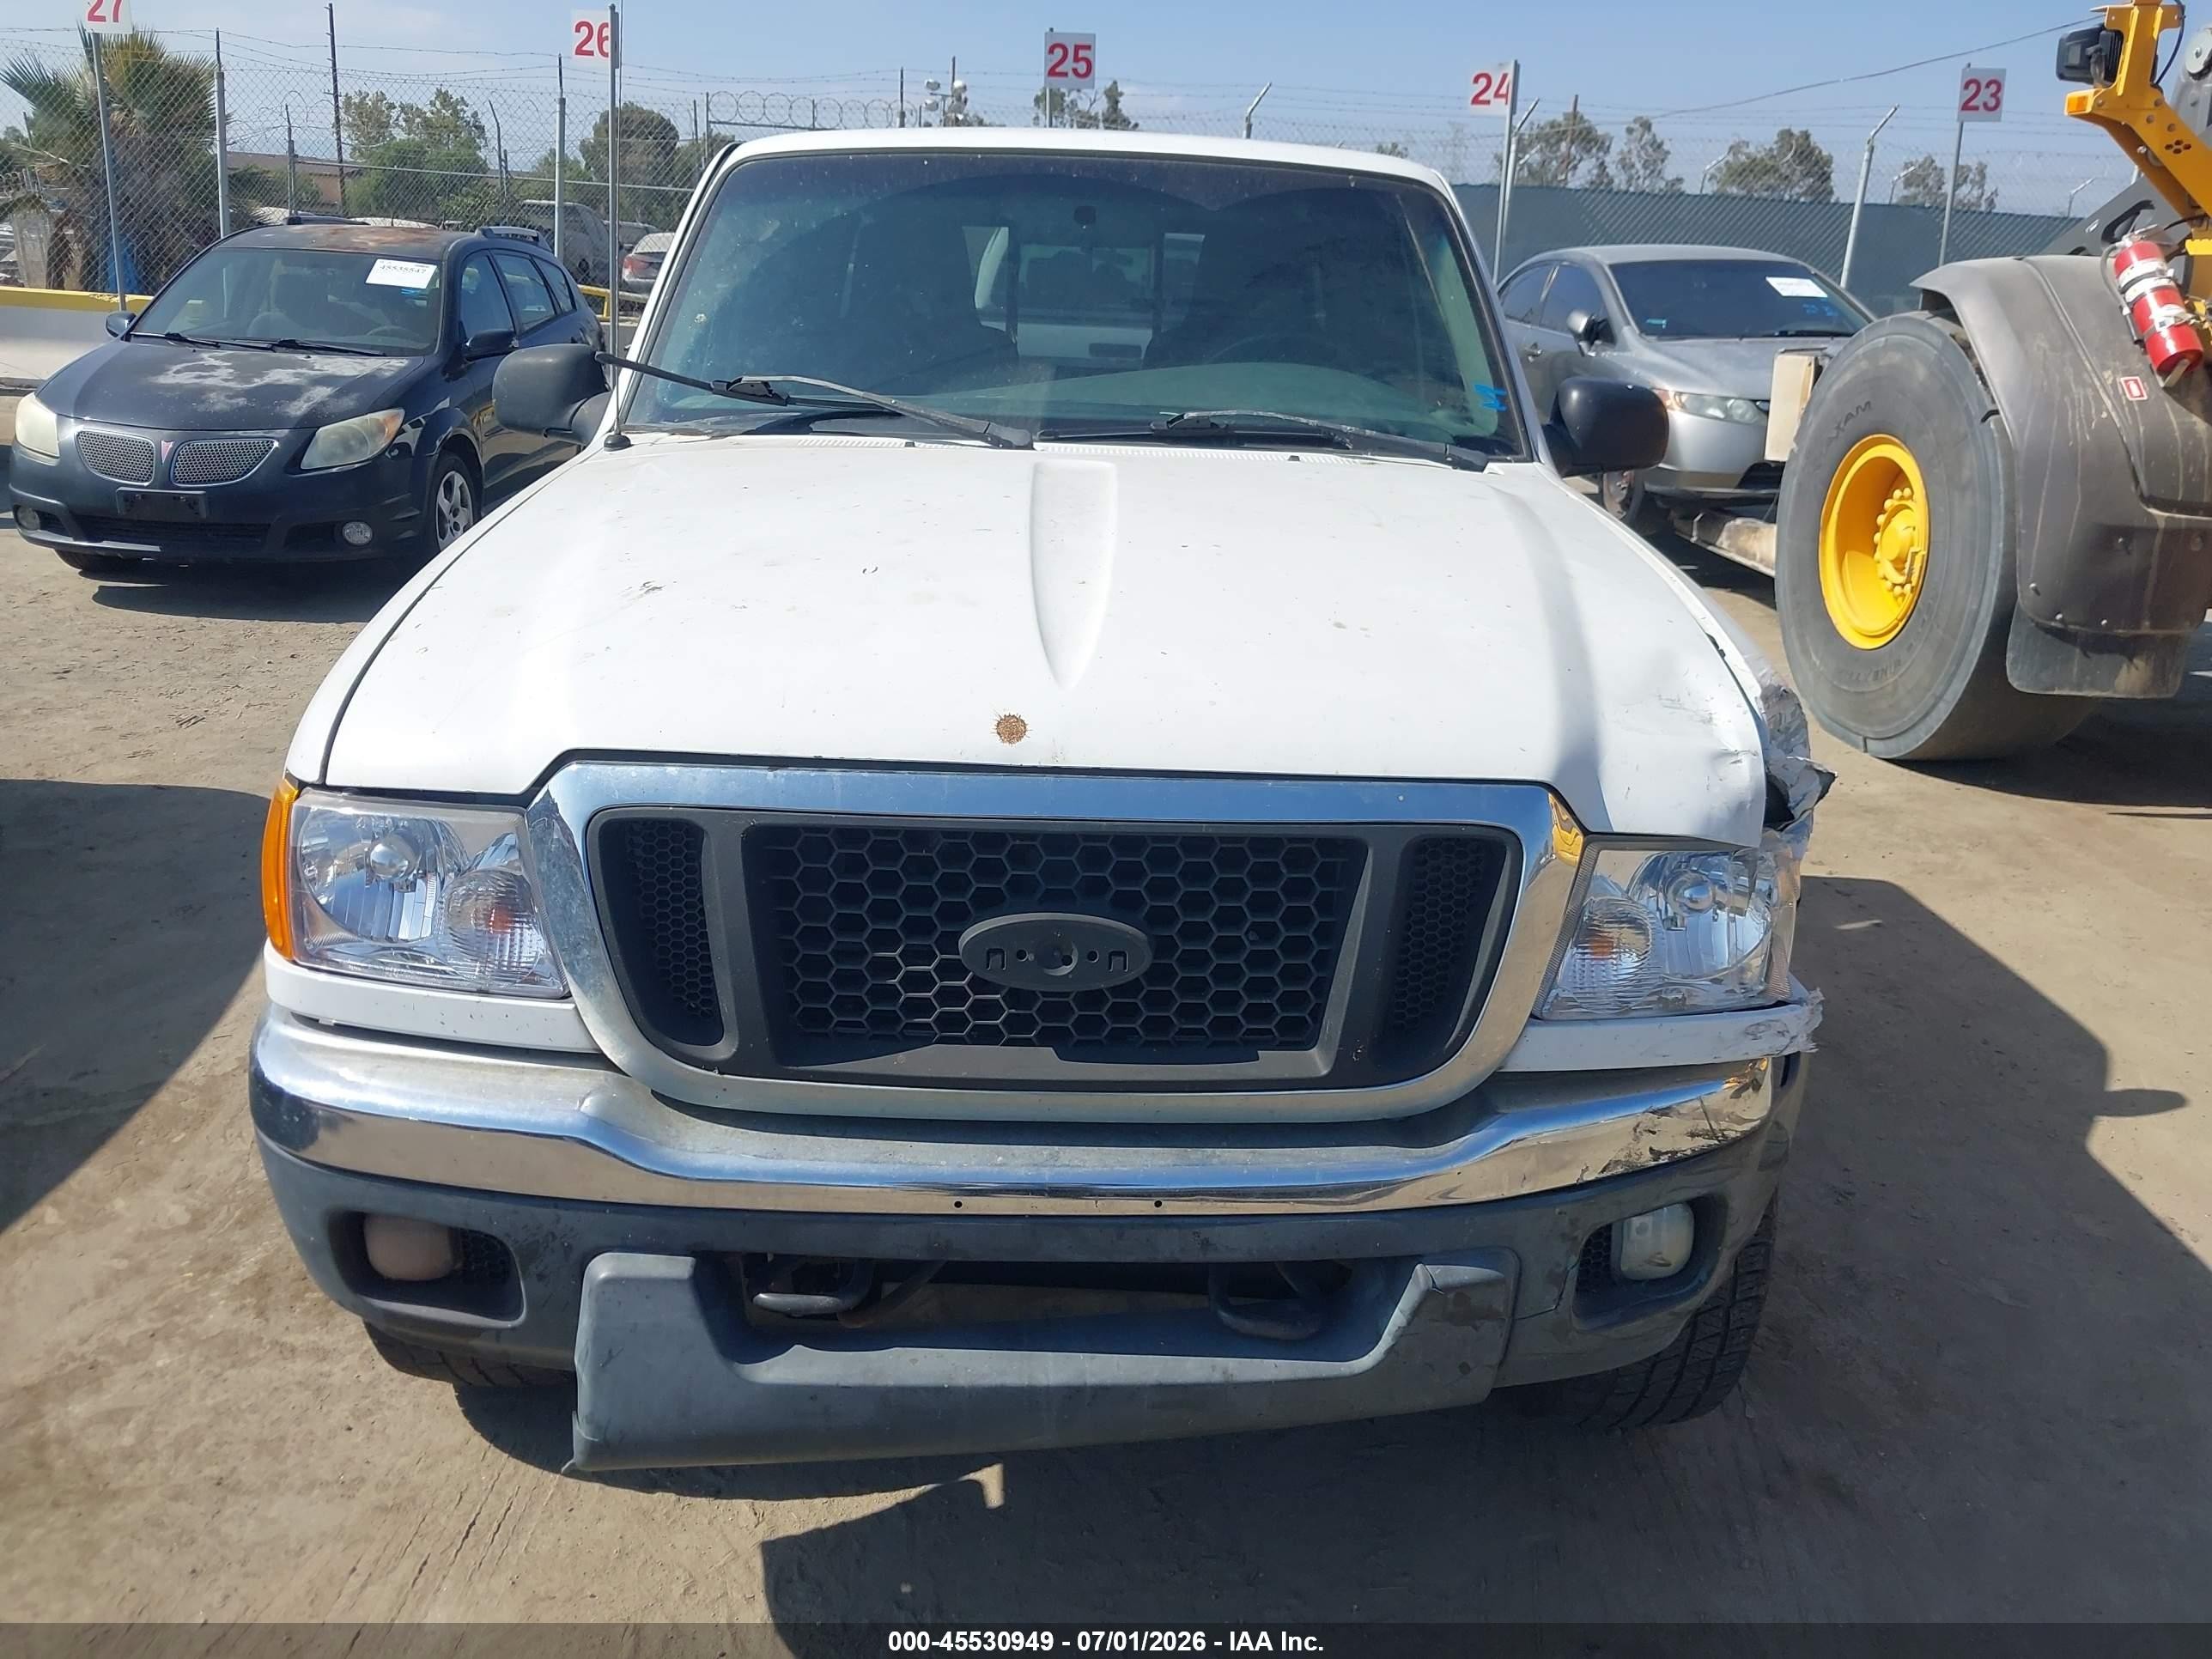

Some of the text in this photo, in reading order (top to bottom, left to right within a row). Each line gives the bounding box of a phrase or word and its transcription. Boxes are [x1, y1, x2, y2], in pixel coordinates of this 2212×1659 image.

[1048, 43, 1092, 79] 25
[1471, 72, 1510, 106] 24
[1960, 78, 2002, 112] 23
